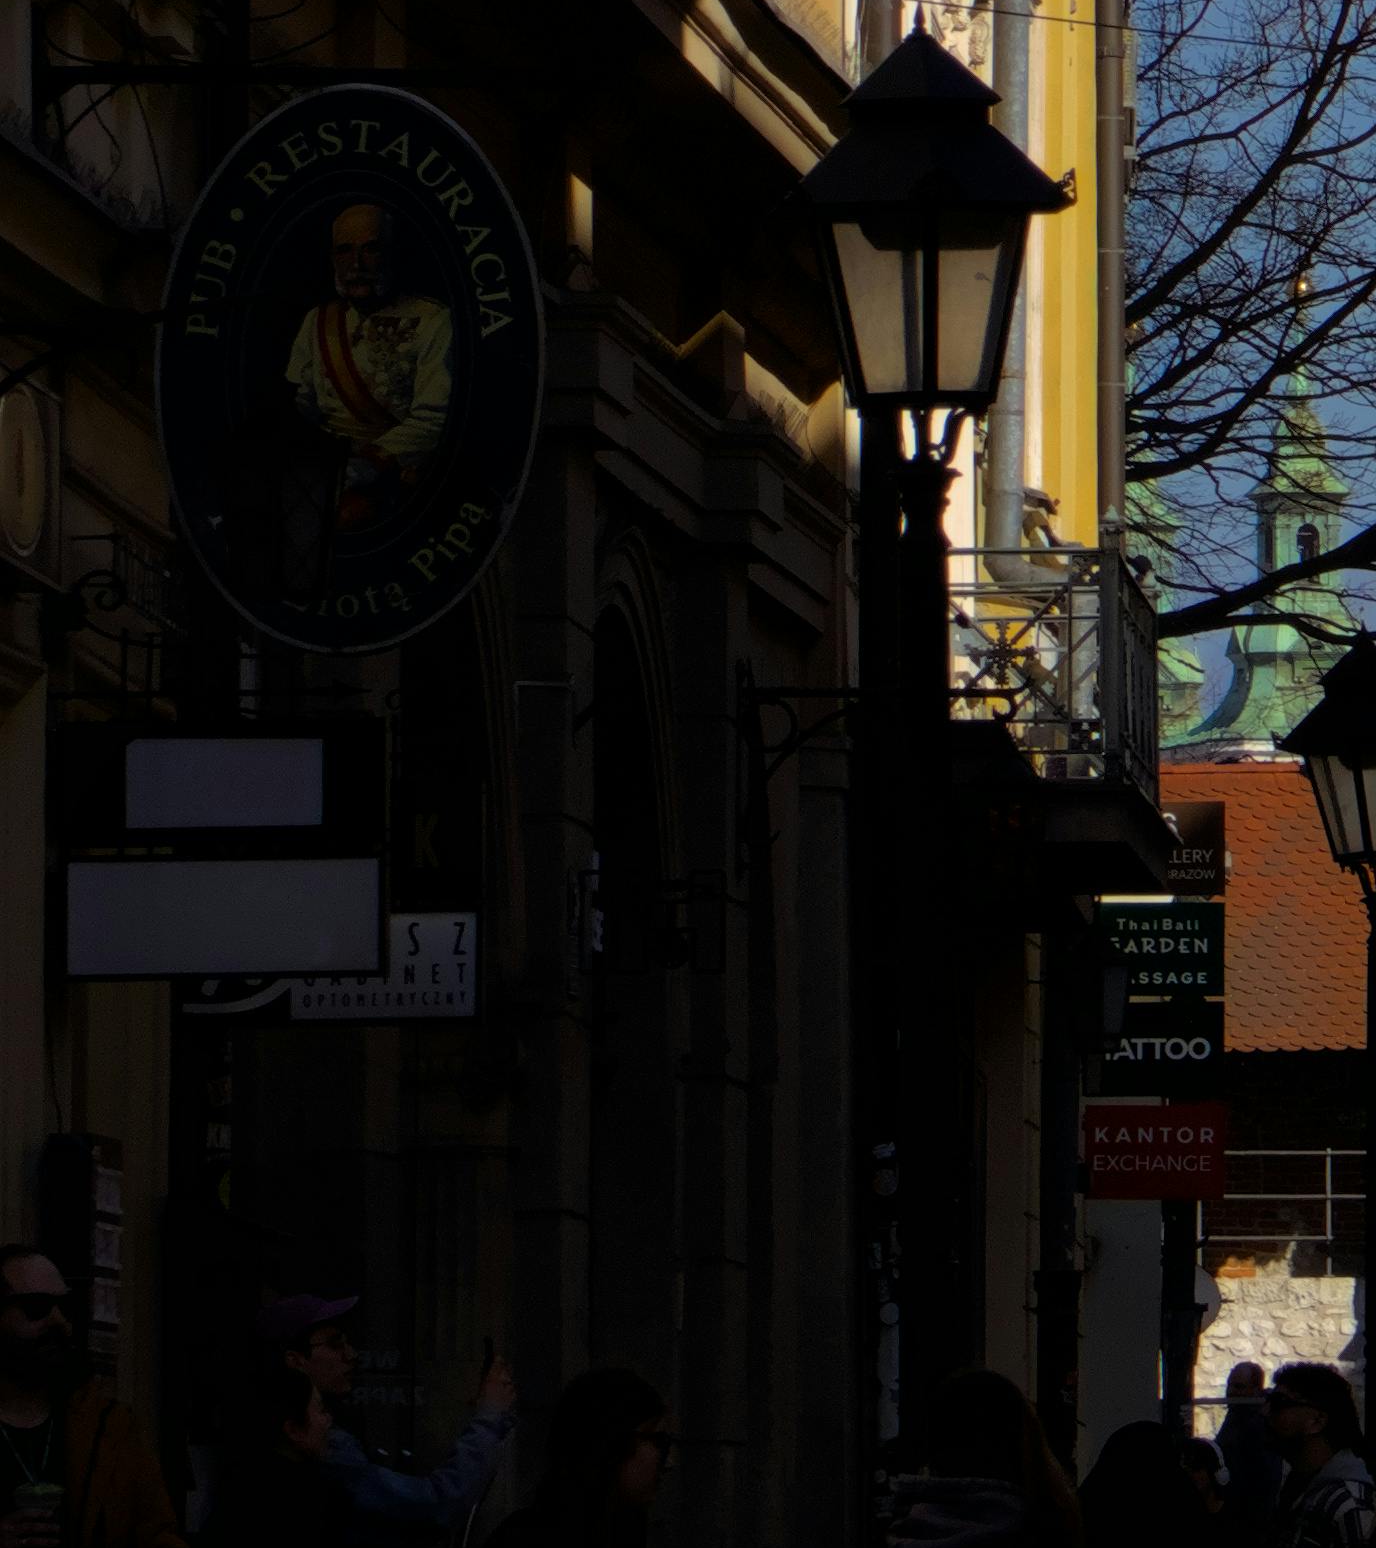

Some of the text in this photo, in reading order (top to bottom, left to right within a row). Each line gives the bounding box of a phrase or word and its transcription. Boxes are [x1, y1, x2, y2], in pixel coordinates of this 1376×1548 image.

[184, 118, 515, 340] PUB RESTAURACJA
[282, 501, 492, 619] ota Pipa
[1168, 848, 1215, 864] LERY
[1131, 972, 1209, 985] SSAGE
[1105, 1037, 1212, 1062] ATTOO
[1094, 1126, 1215, 1144] KANTOR
[1092, 1154, 1213, 1172] EXCHANGE
